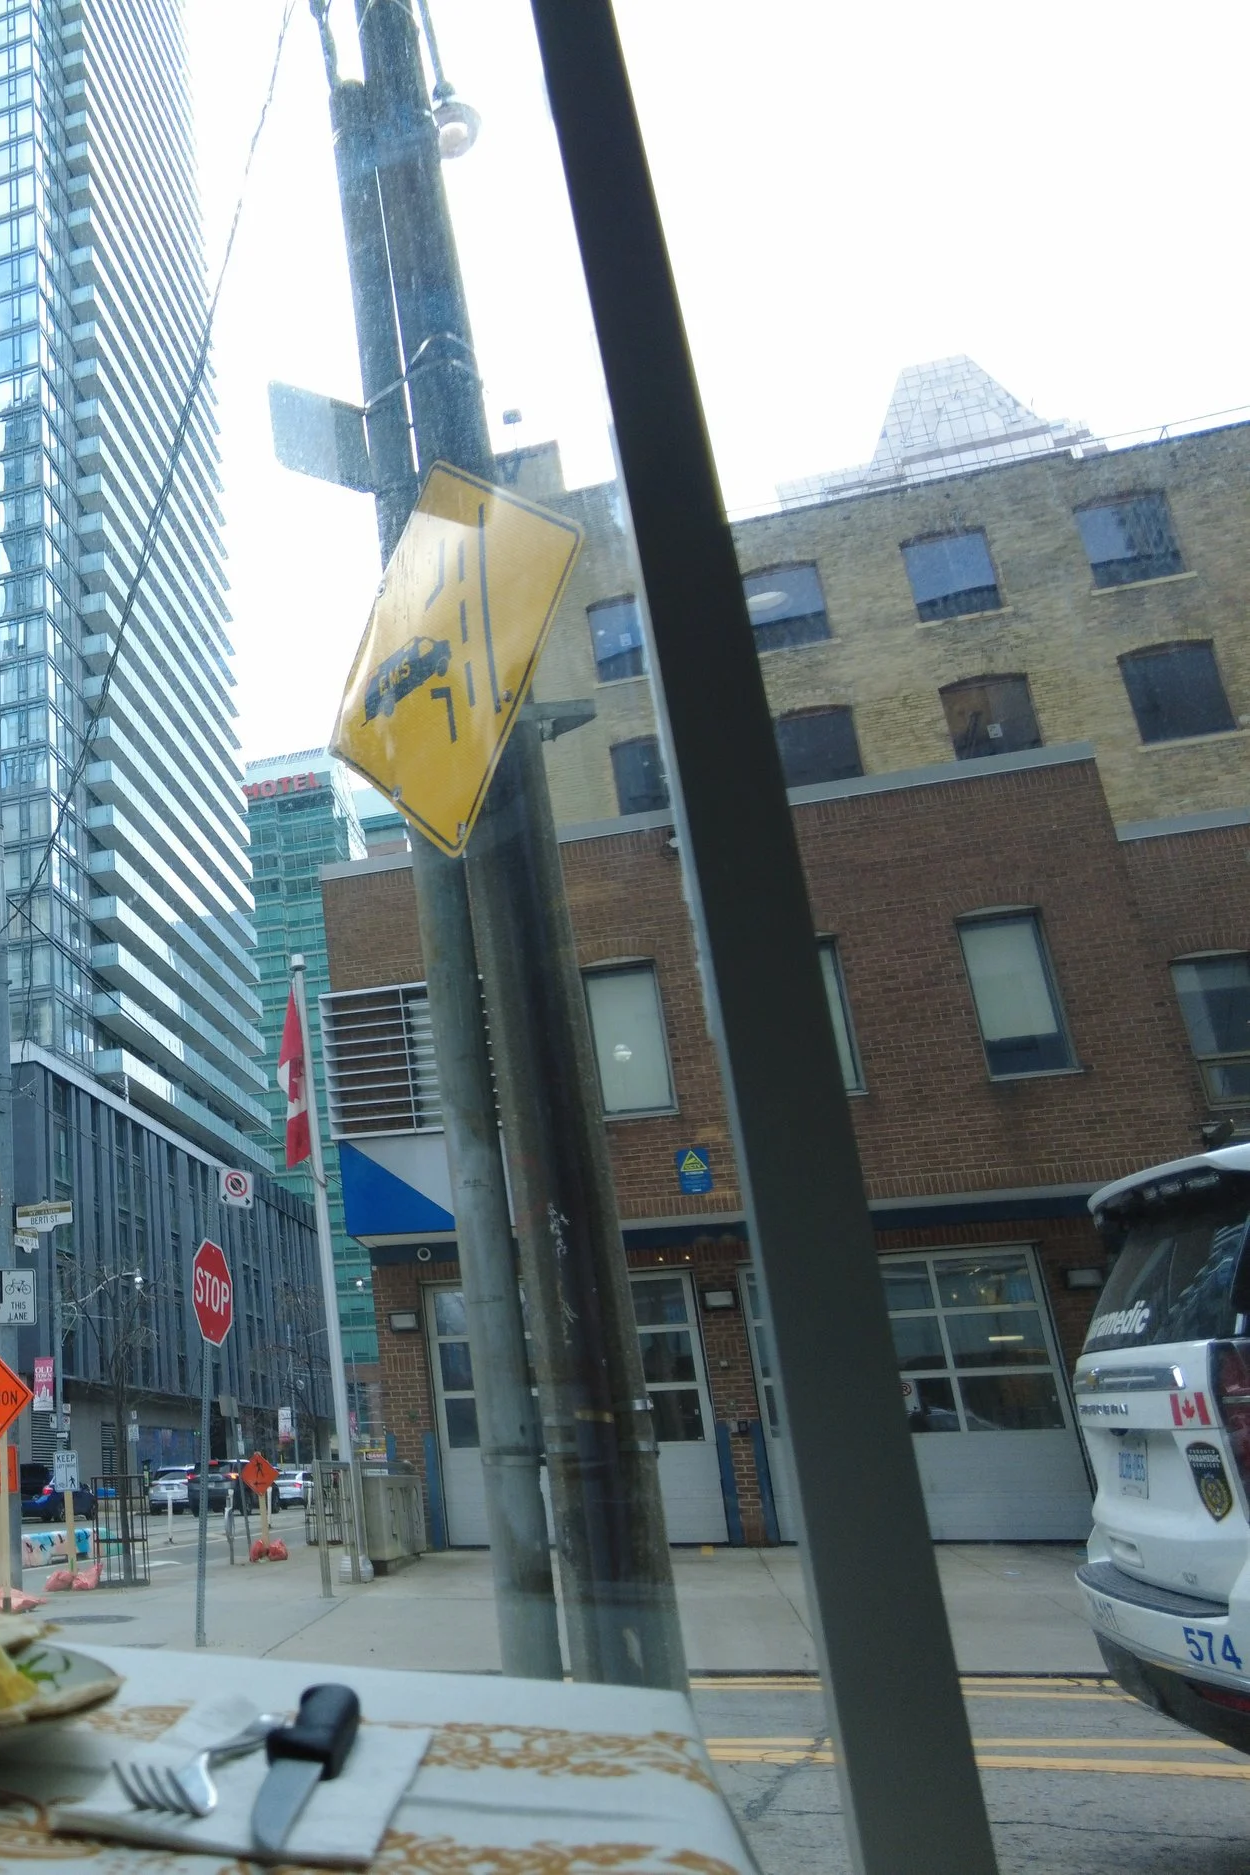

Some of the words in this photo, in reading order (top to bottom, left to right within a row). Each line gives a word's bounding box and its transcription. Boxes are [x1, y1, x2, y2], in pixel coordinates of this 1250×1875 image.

[379, 659, 410, 696] EMS
[31, 1216, 49, 1225] BERTI
[50, 1215, 59, 1223] ST
[195, 1266, 230, 1316] STOP
[11, 1301, 26, 1310] THIS
[10, 1312, 28, 1320] LANE
[56, 1454, 75, 1463] KEEP
[1183, 1626, 1242, 1670] 574
